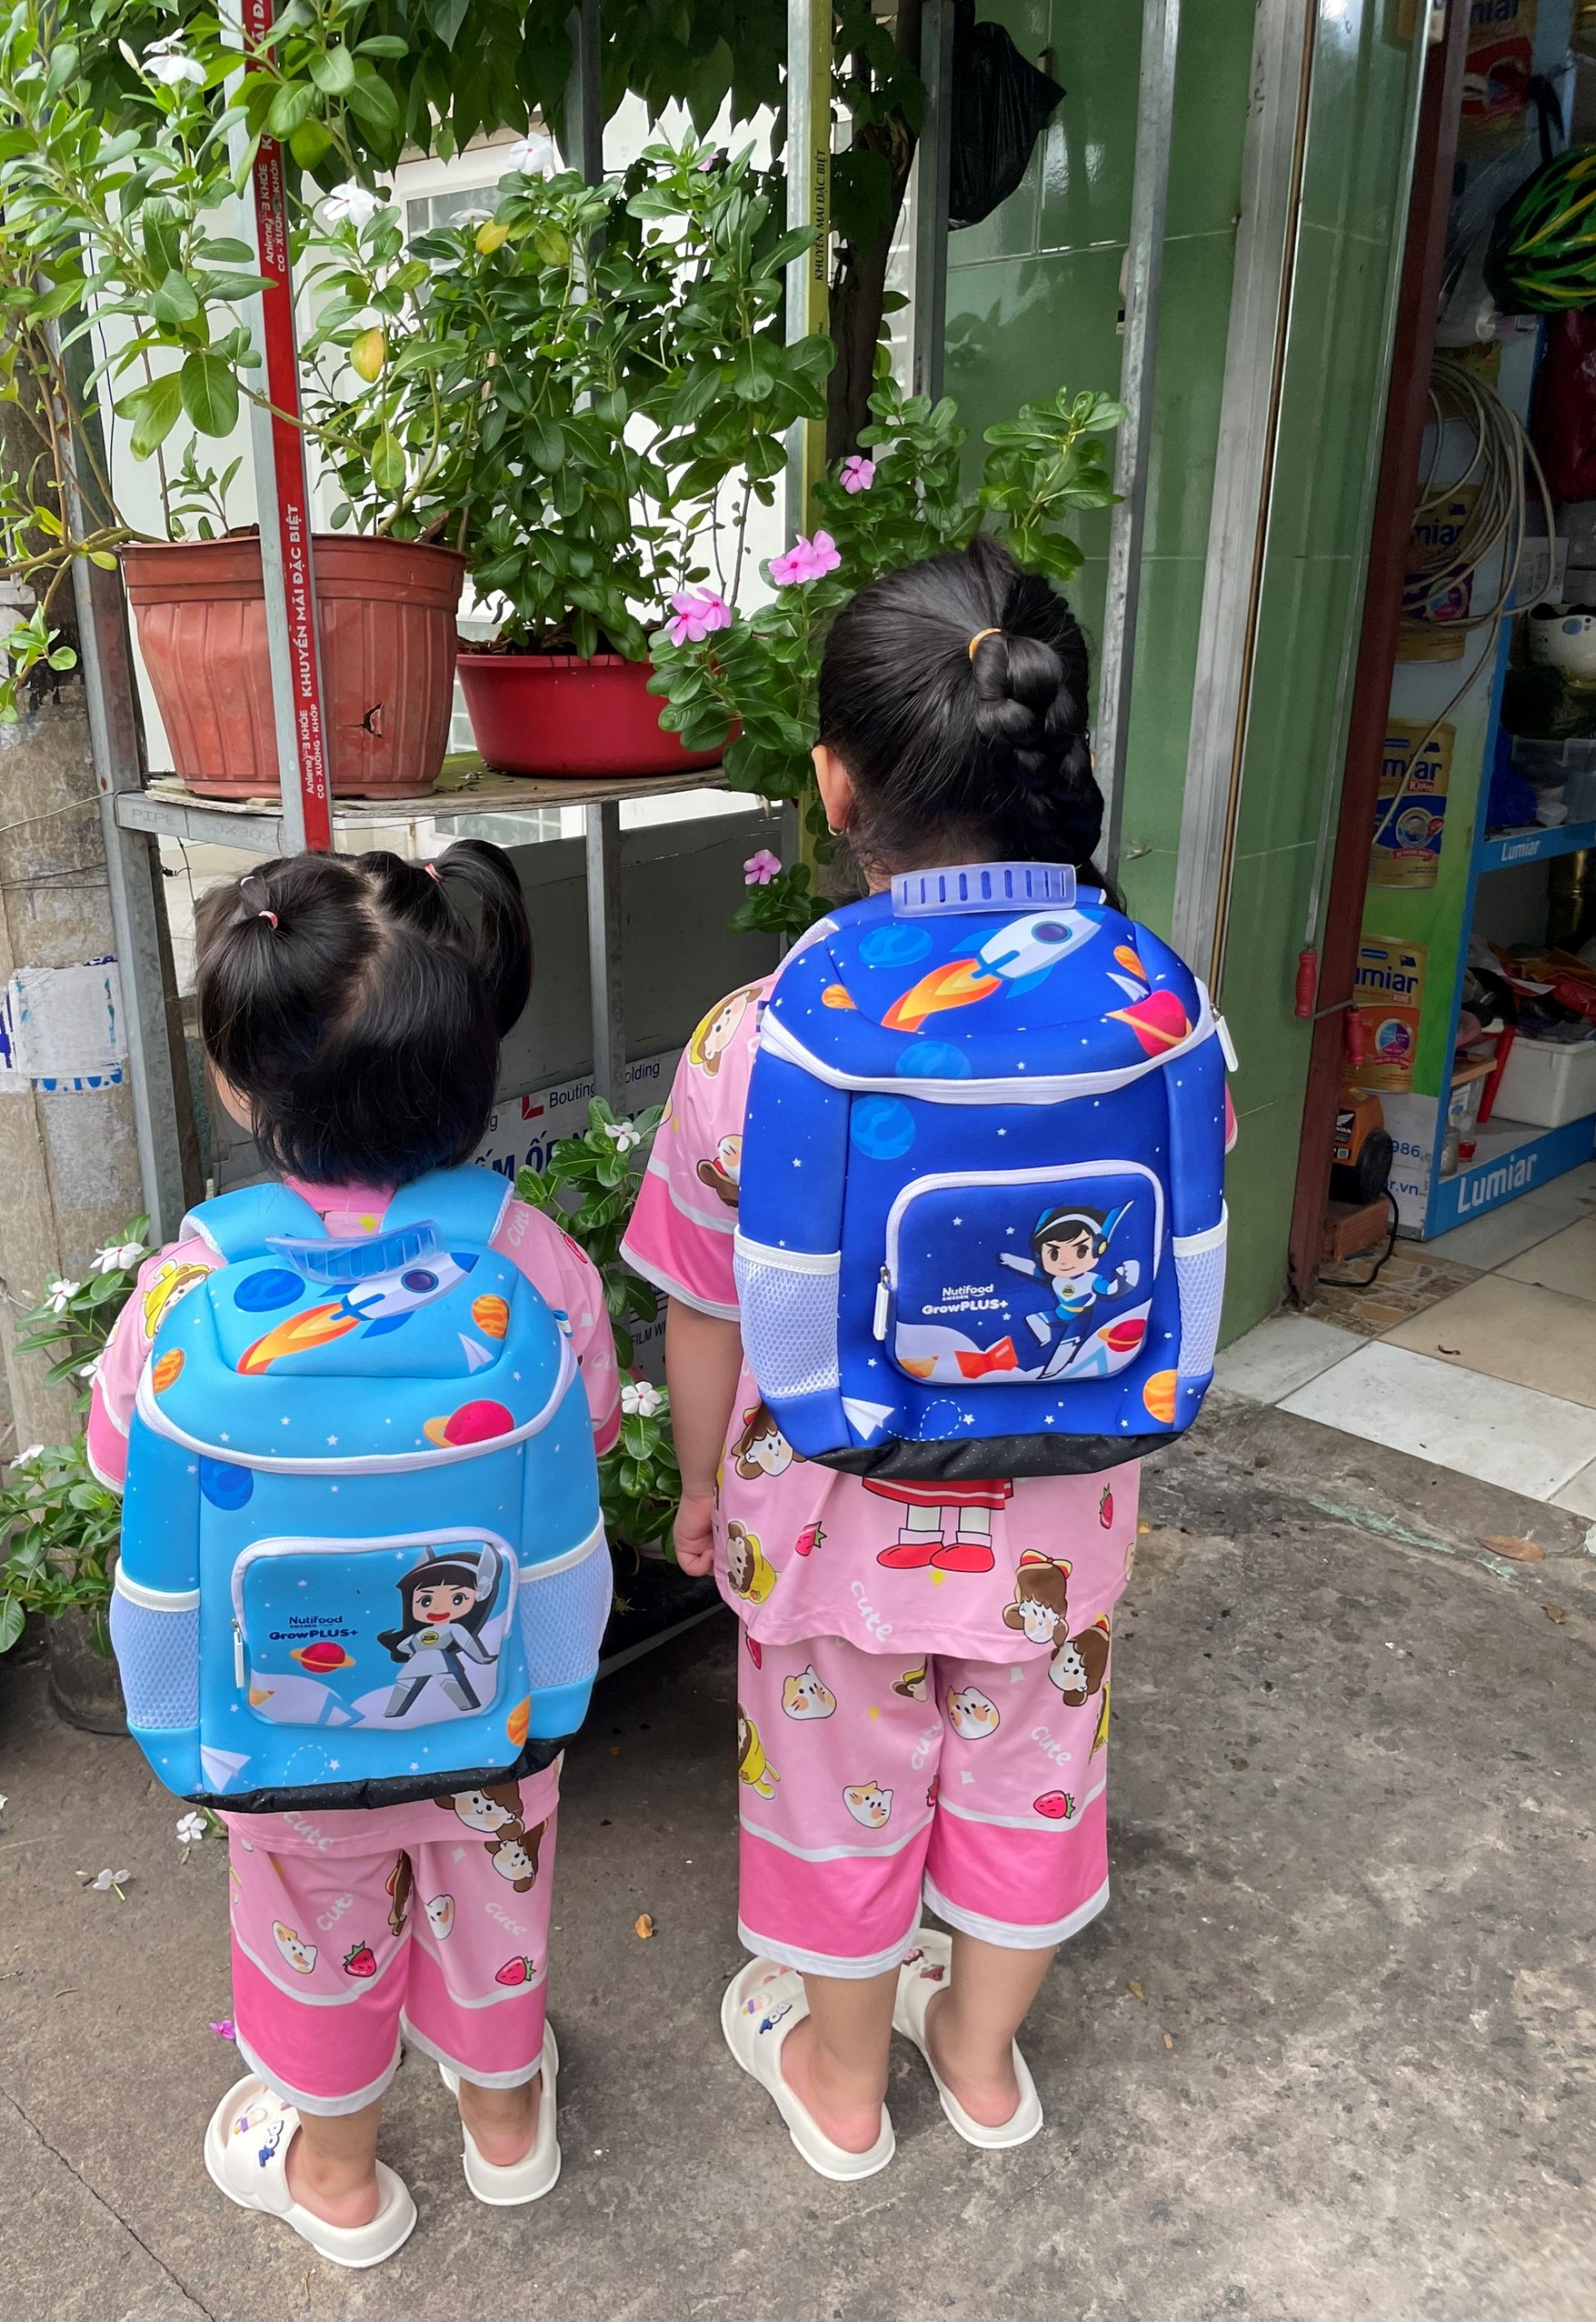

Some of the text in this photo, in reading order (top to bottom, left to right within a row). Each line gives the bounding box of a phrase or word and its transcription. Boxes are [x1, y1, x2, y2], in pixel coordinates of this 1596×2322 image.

[285, 504, 313, 696] KHUYẾN MÃI ĐẶC BIỆT
[298, 709, 315, 794] Anlene 3 KHỎE
[1501, 837, 1541, 862] Lumiar
[624, 1062, 660, 1084] olding
[1457, 1153, 1538, 1214] Lumiar
[942, 1283, 994, 1297] Nutifood
[922, 1298, 1009, 1316] GrowPLUS+
[288, 1615, 343, 1626] Nutifood
[850, 1580, 893, 1643] cute
[268, 1628, 359, 1641] GrowPLUS+
[1031, 1726, 1072, 1767] cute
